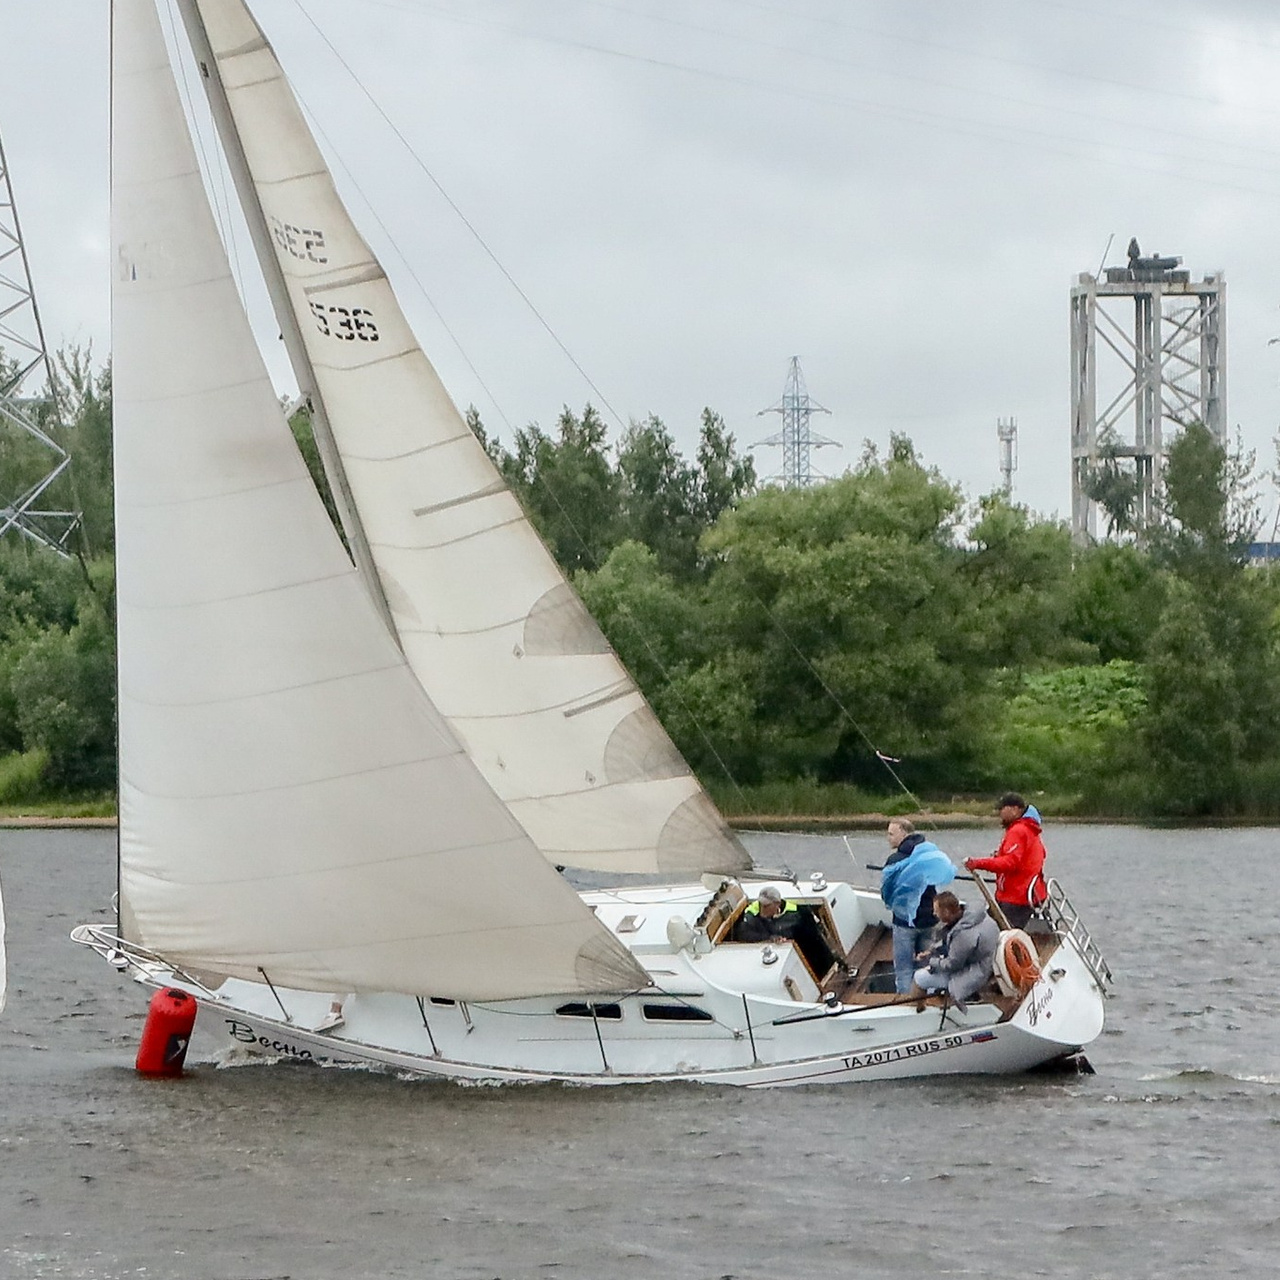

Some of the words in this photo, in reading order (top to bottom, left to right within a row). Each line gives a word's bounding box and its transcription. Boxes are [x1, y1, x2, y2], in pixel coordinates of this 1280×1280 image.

[309, 301, 379, 341] 536
[842, 1057, 863, 1069] TA
[865, 1048, 901, 1065] 2071
[906, 1040, 940, 1057] RUS
[945, 1035, 963, 1047] 50
